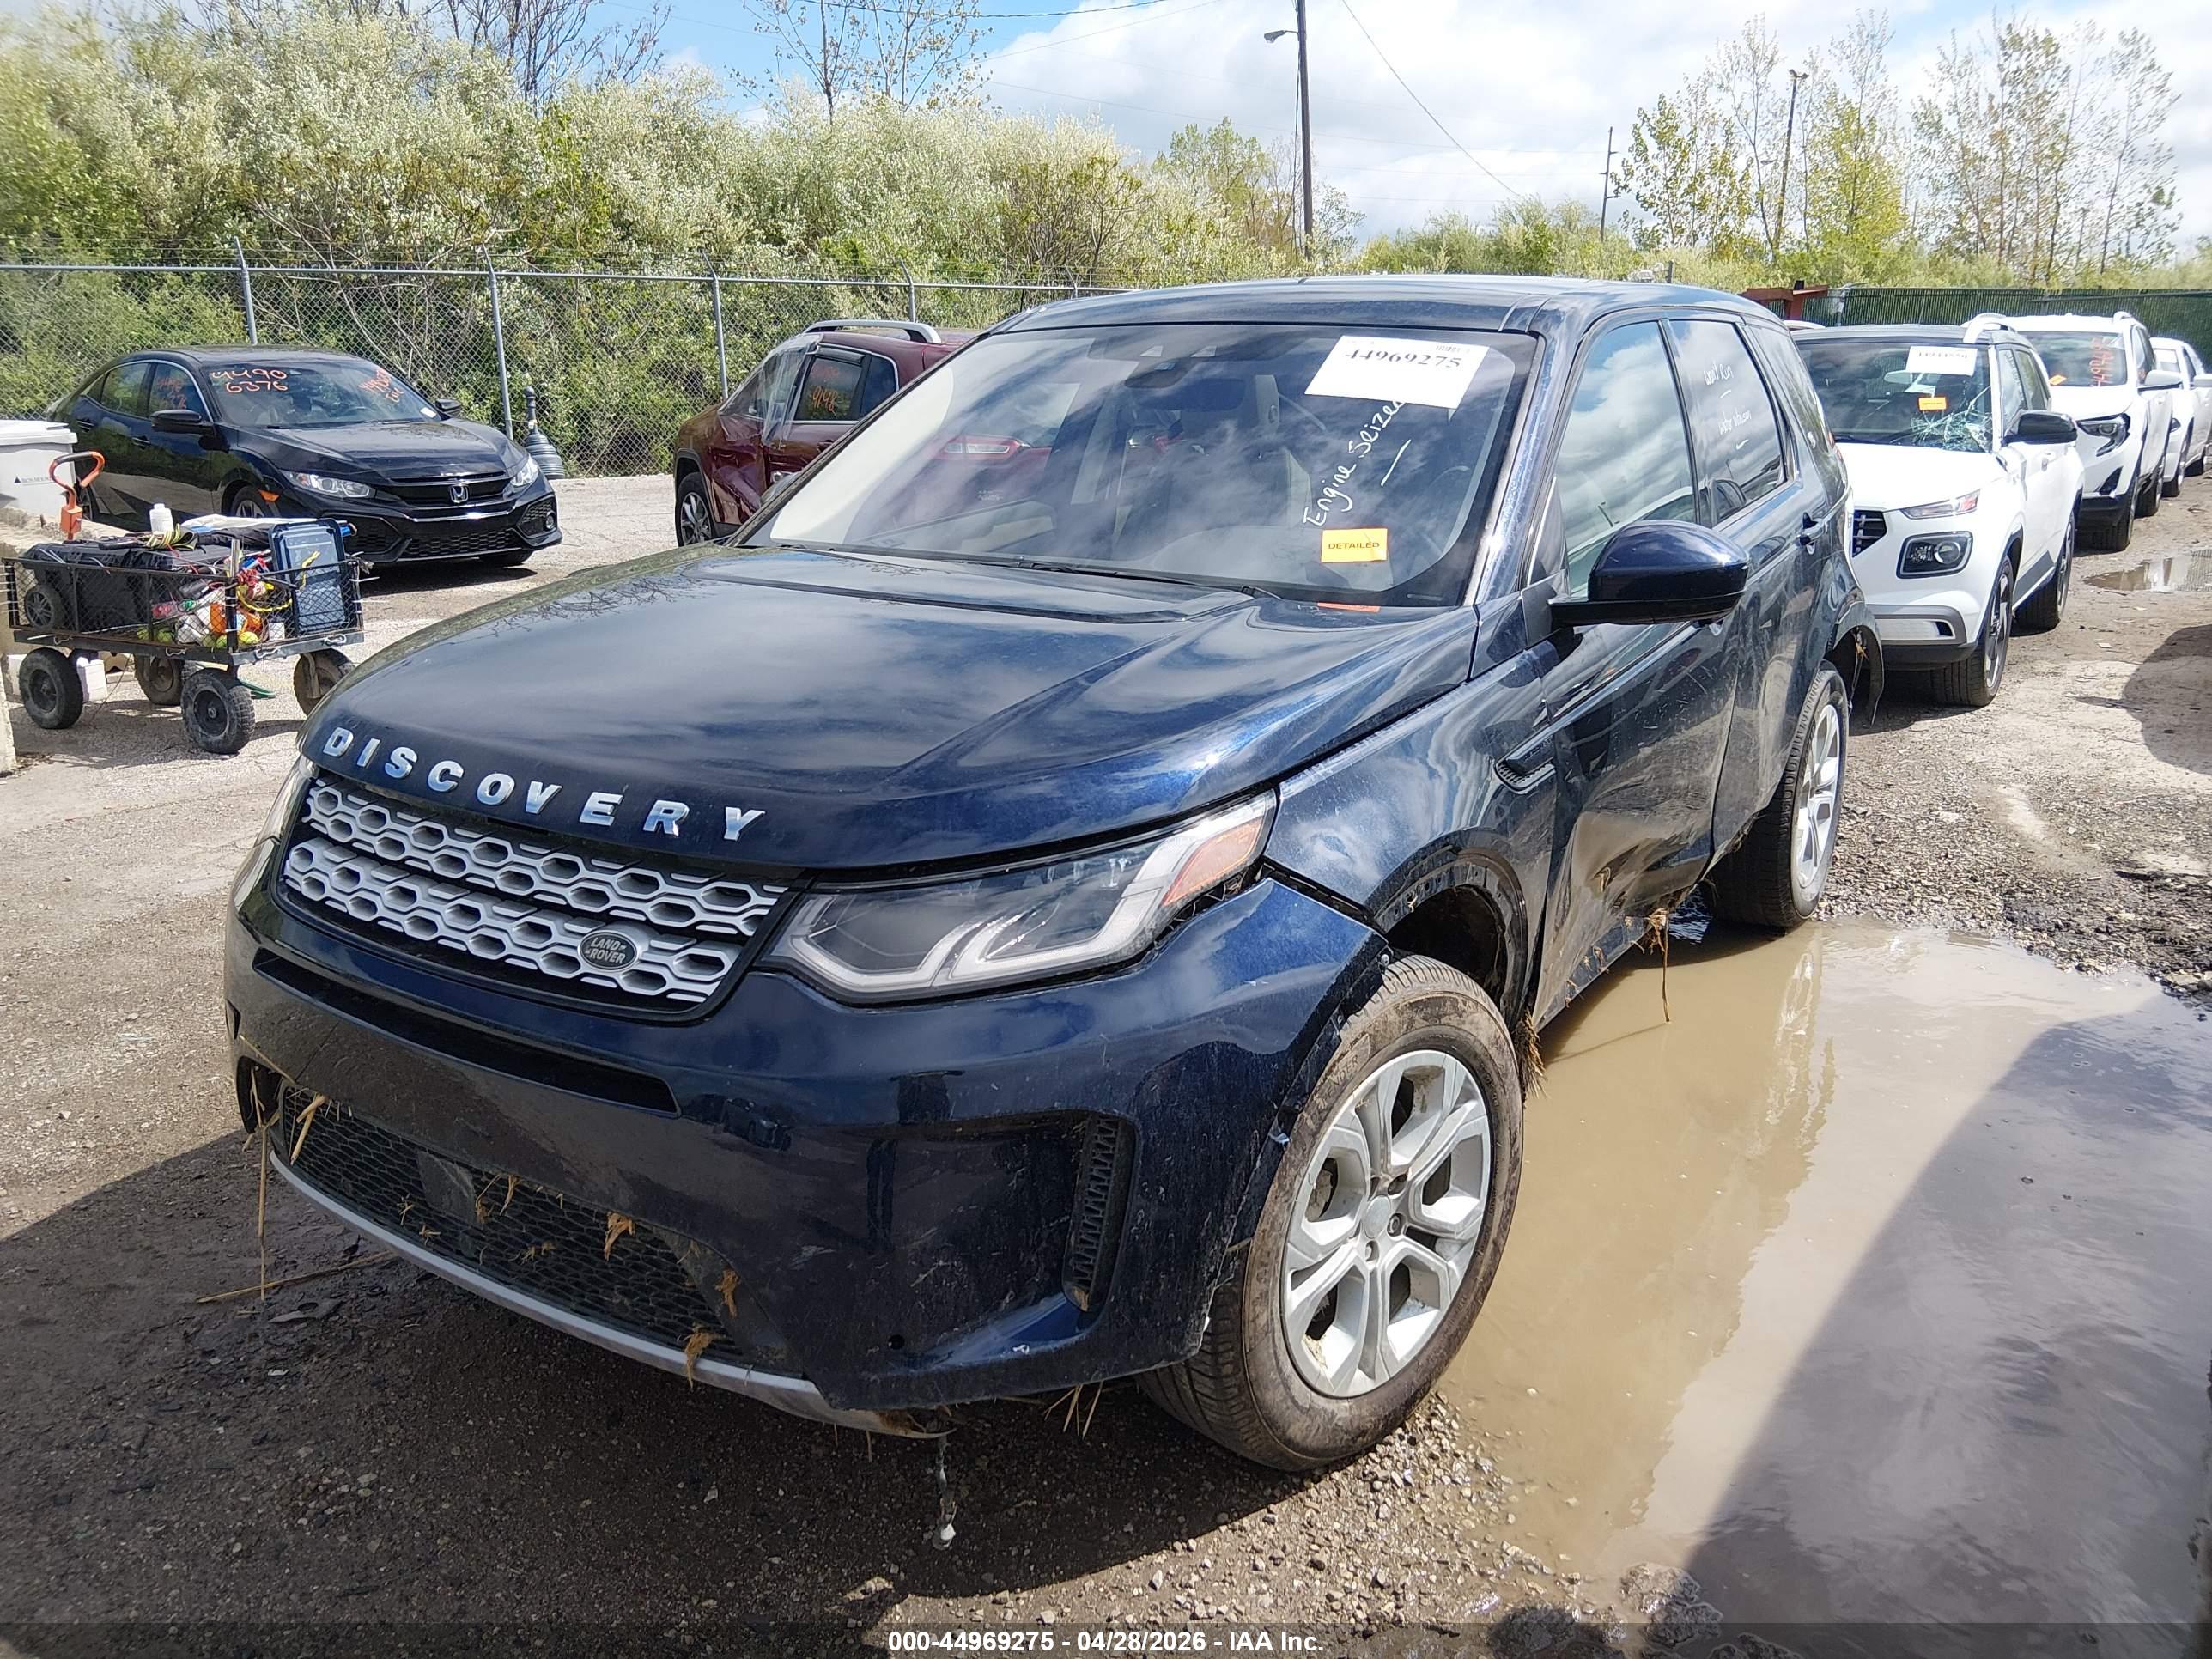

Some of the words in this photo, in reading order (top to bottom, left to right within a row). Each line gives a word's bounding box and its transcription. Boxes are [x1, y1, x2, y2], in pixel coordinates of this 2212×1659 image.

[1345, 349, 1462, 368] 44969275
[211, 368, 288, 380] 4490
[1303, 463, 1357, 526] Engine
[1328, 541, 1380, 550] DETAILED
[322, 726, 766, 842] DISCOVERY
[590, 937, 621, 951] LAND
[590, 948, 626, 964] ROVER
